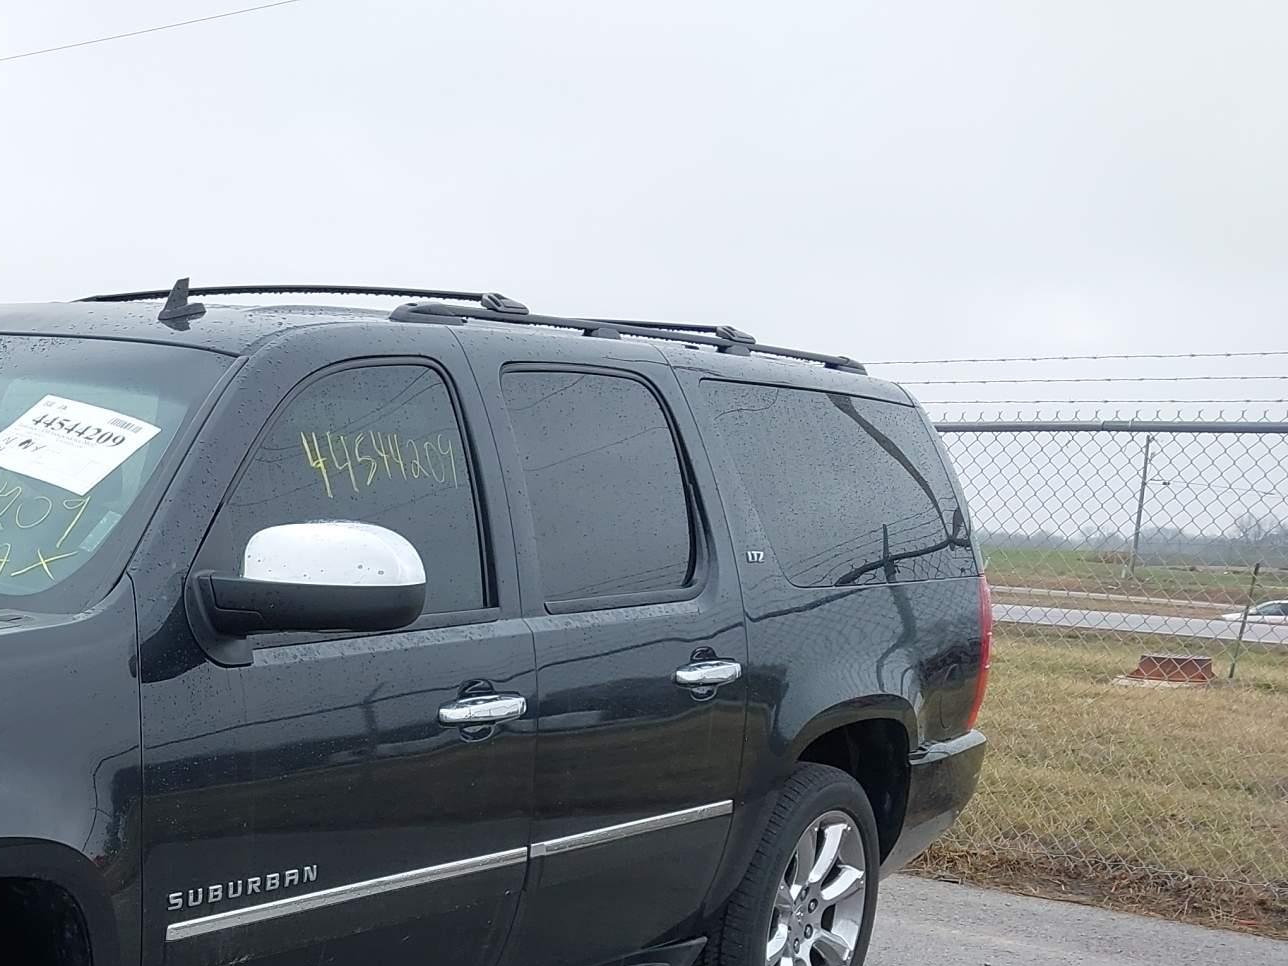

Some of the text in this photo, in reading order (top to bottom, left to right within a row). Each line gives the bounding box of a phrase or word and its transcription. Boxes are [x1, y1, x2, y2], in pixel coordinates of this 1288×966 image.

[32, 413, 126, 448] 44544209
[301, 431, 457, 498] 44544209
[167, 864, 318, 911] SUBURBAN
